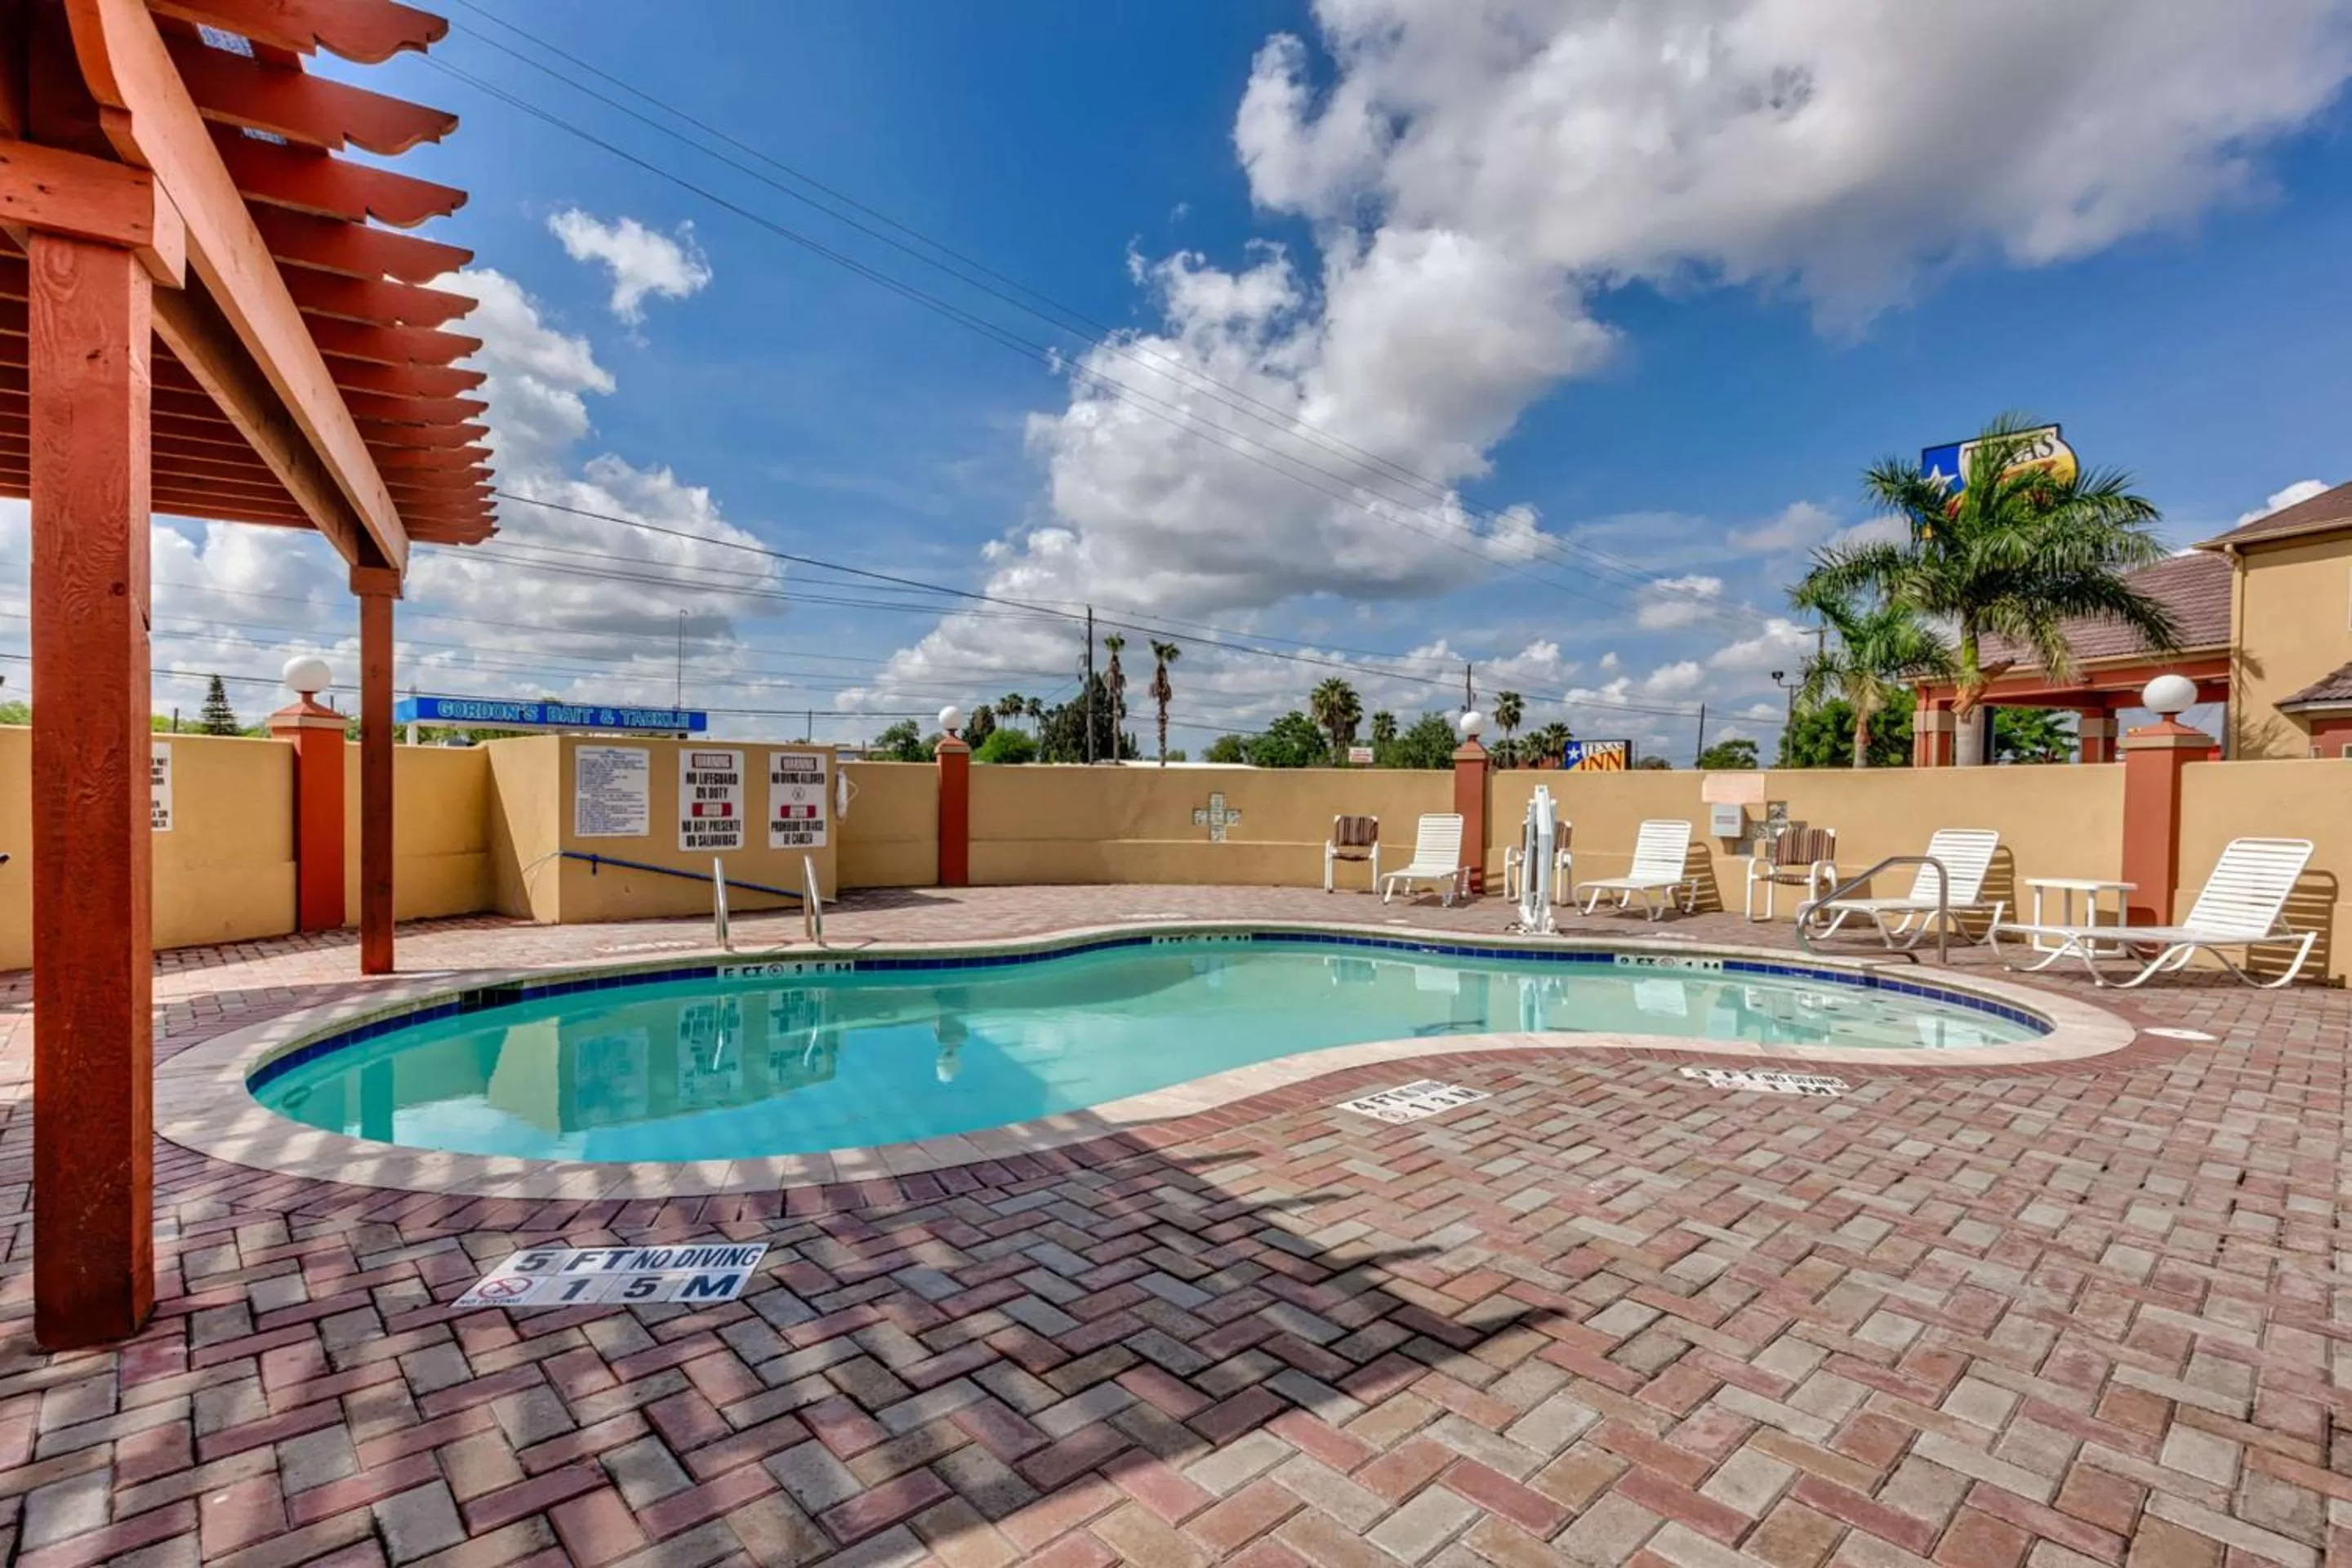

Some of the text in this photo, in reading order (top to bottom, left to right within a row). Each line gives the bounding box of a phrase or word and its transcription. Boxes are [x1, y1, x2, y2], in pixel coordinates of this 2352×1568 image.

[437, 700, 690, 729] GORDON'S BAIT & TACKLE
[1584, 743, 1624, 756] TEXAS
[1581, 749, 1623, 771] INN
[686, 772, 738, 785] NO LIFEGUARD
[771, 773, 825, 784] NO DIVING ALLOWED
[696, 786, 728, 800] ON DUTY
[682, 820, 691, 833] NO
[1352, 1093, 1405, 1111] 4 FT
[514, 1247, 763, 1273] 5 FT NO DIVING
[680, 1273, 740, 1298] M
